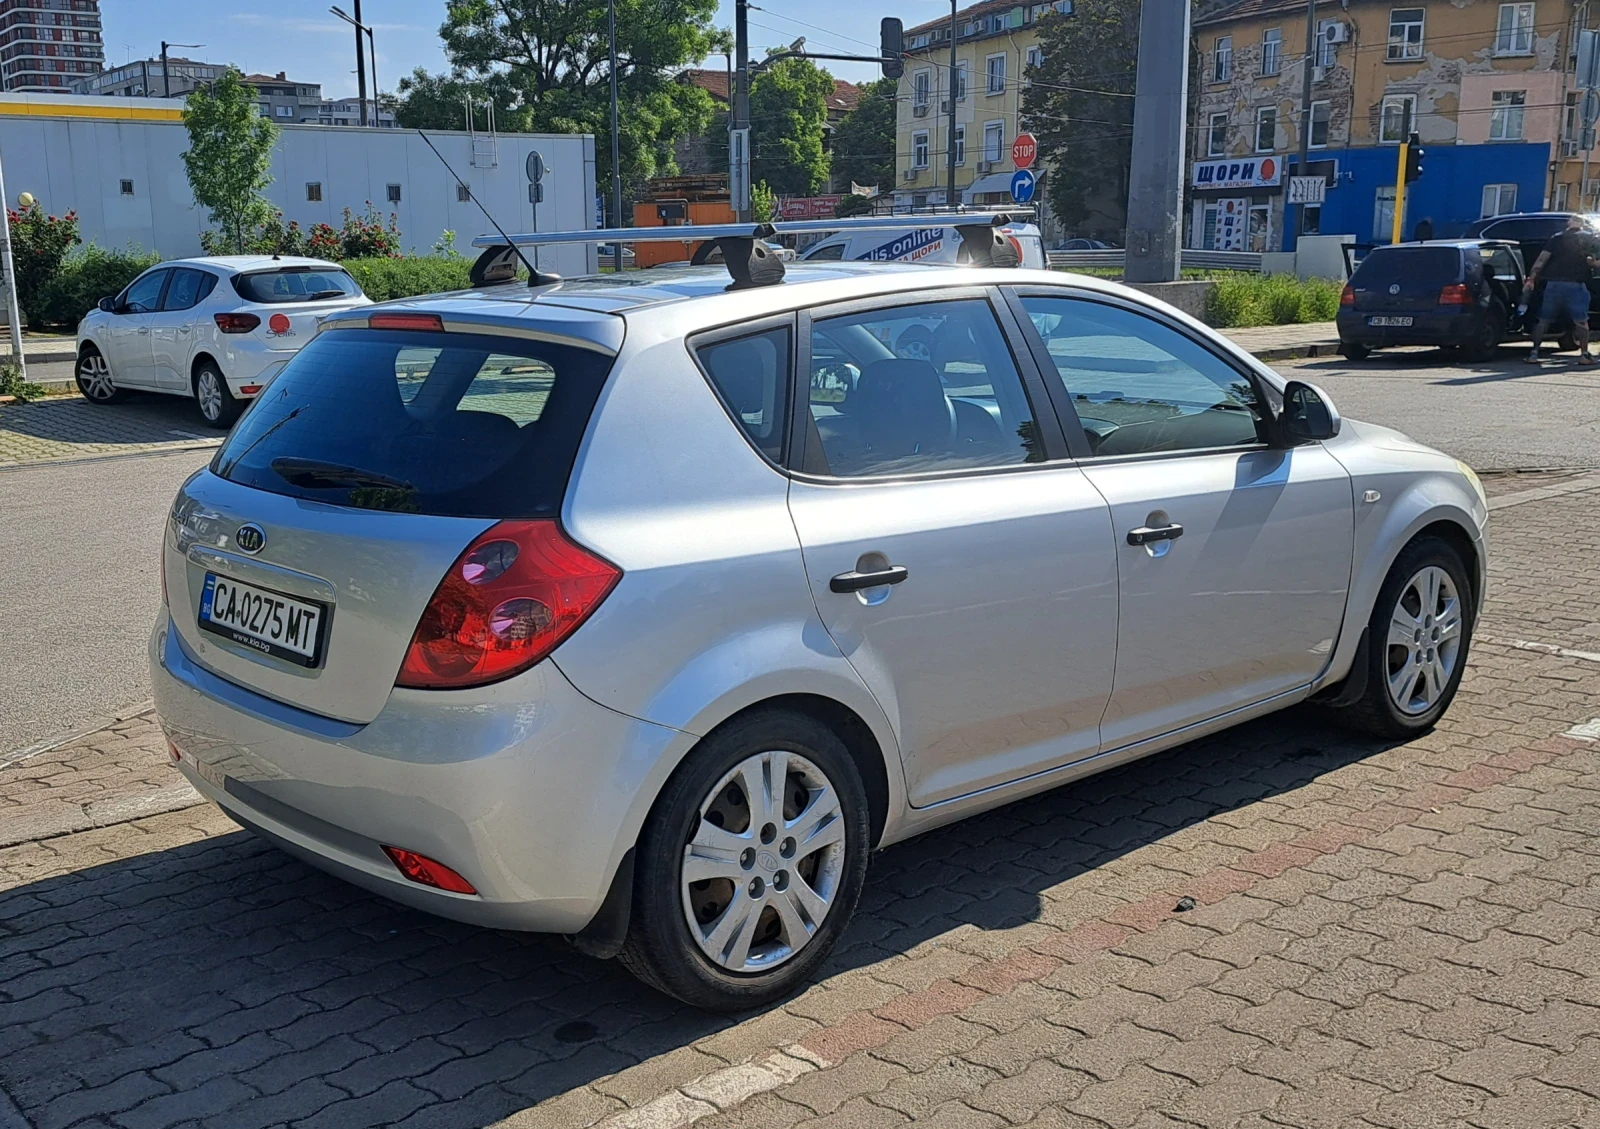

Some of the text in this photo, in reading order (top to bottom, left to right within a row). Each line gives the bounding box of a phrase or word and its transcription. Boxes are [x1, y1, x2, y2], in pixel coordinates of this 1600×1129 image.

[1014, 145, 1034, 158] STOP
[1197, 163, 1255, 182] ЩОРИ
[863, 228, 942, 260] lis.online
[912, 241, 941, 261] ЩОРИ
[265, 327, 296, 339] Solis
[239, 529, 258, 549] KIA
[202, 602, 211, 614] BG
[233, 632, 270, 653] www.kia.bg
